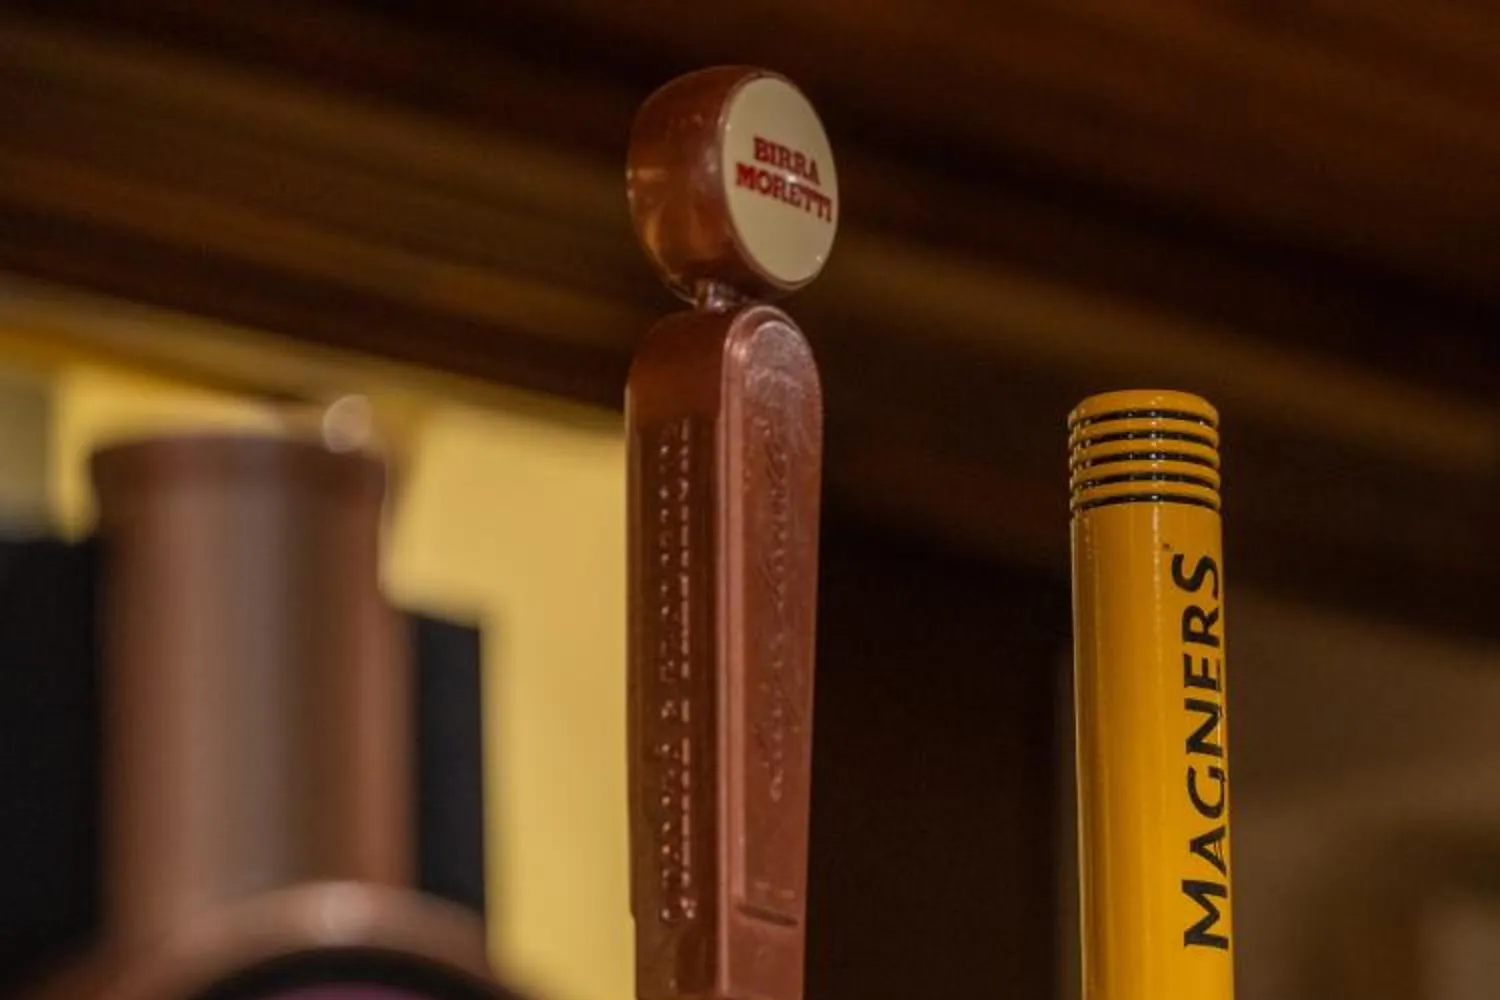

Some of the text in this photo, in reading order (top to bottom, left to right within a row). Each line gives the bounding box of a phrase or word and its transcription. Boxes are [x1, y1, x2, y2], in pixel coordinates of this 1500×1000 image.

[754, 136, 821, 185] BIRRA
[736, 163, 832, 222] MORETTI
[1171, 552, 1230, 951] MAGNERS
